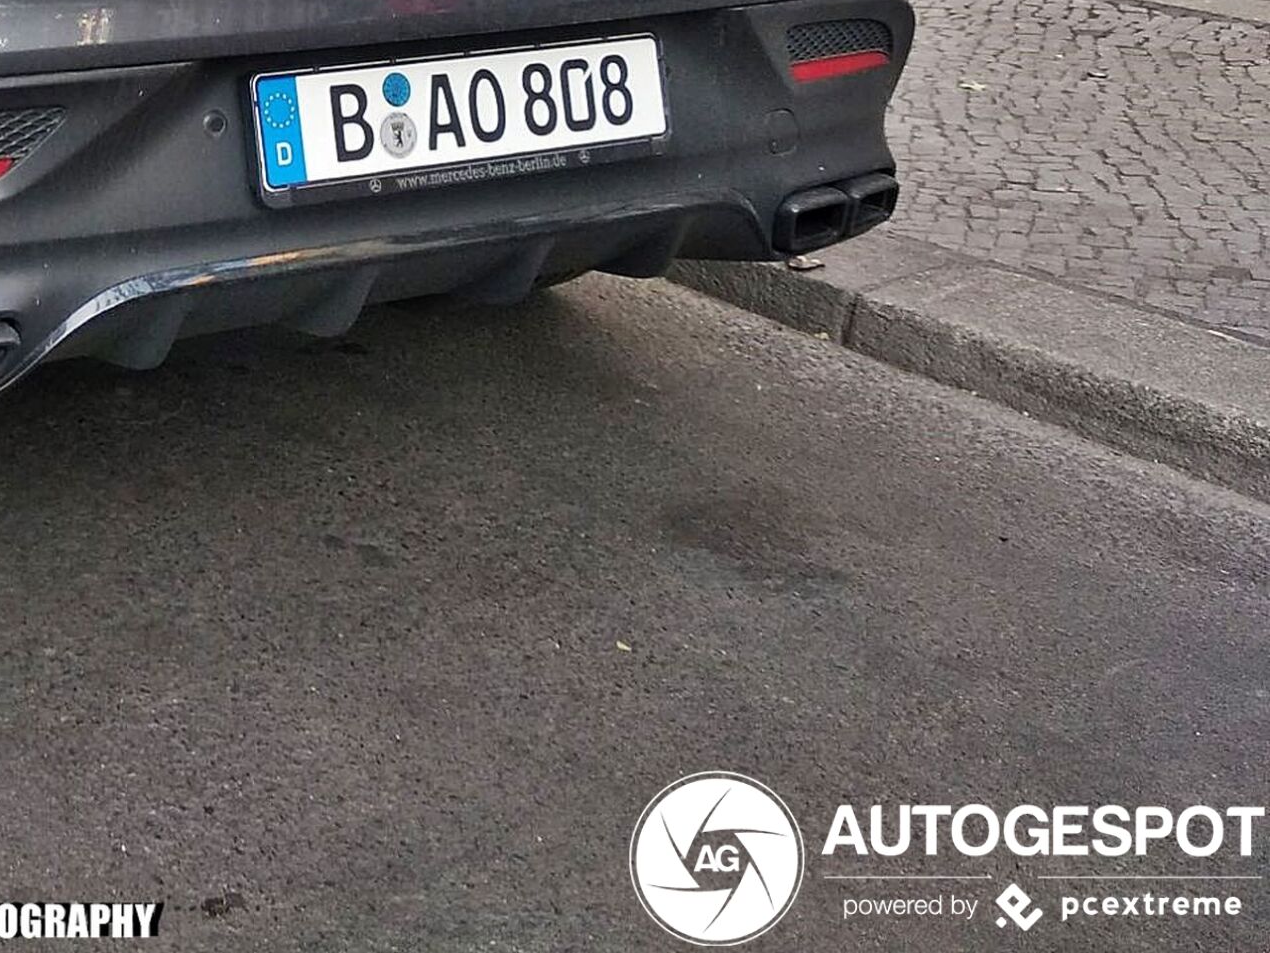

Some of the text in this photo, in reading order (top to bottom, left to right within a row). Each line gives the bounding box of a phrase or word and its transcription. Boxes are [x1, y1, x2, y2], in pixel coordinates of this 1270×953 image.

[330, 54, 634, 163] B AO 808
[276, 142, 292, 166] D
[397, 153, 567, 190] www.mercedes-benz-berlin.de
